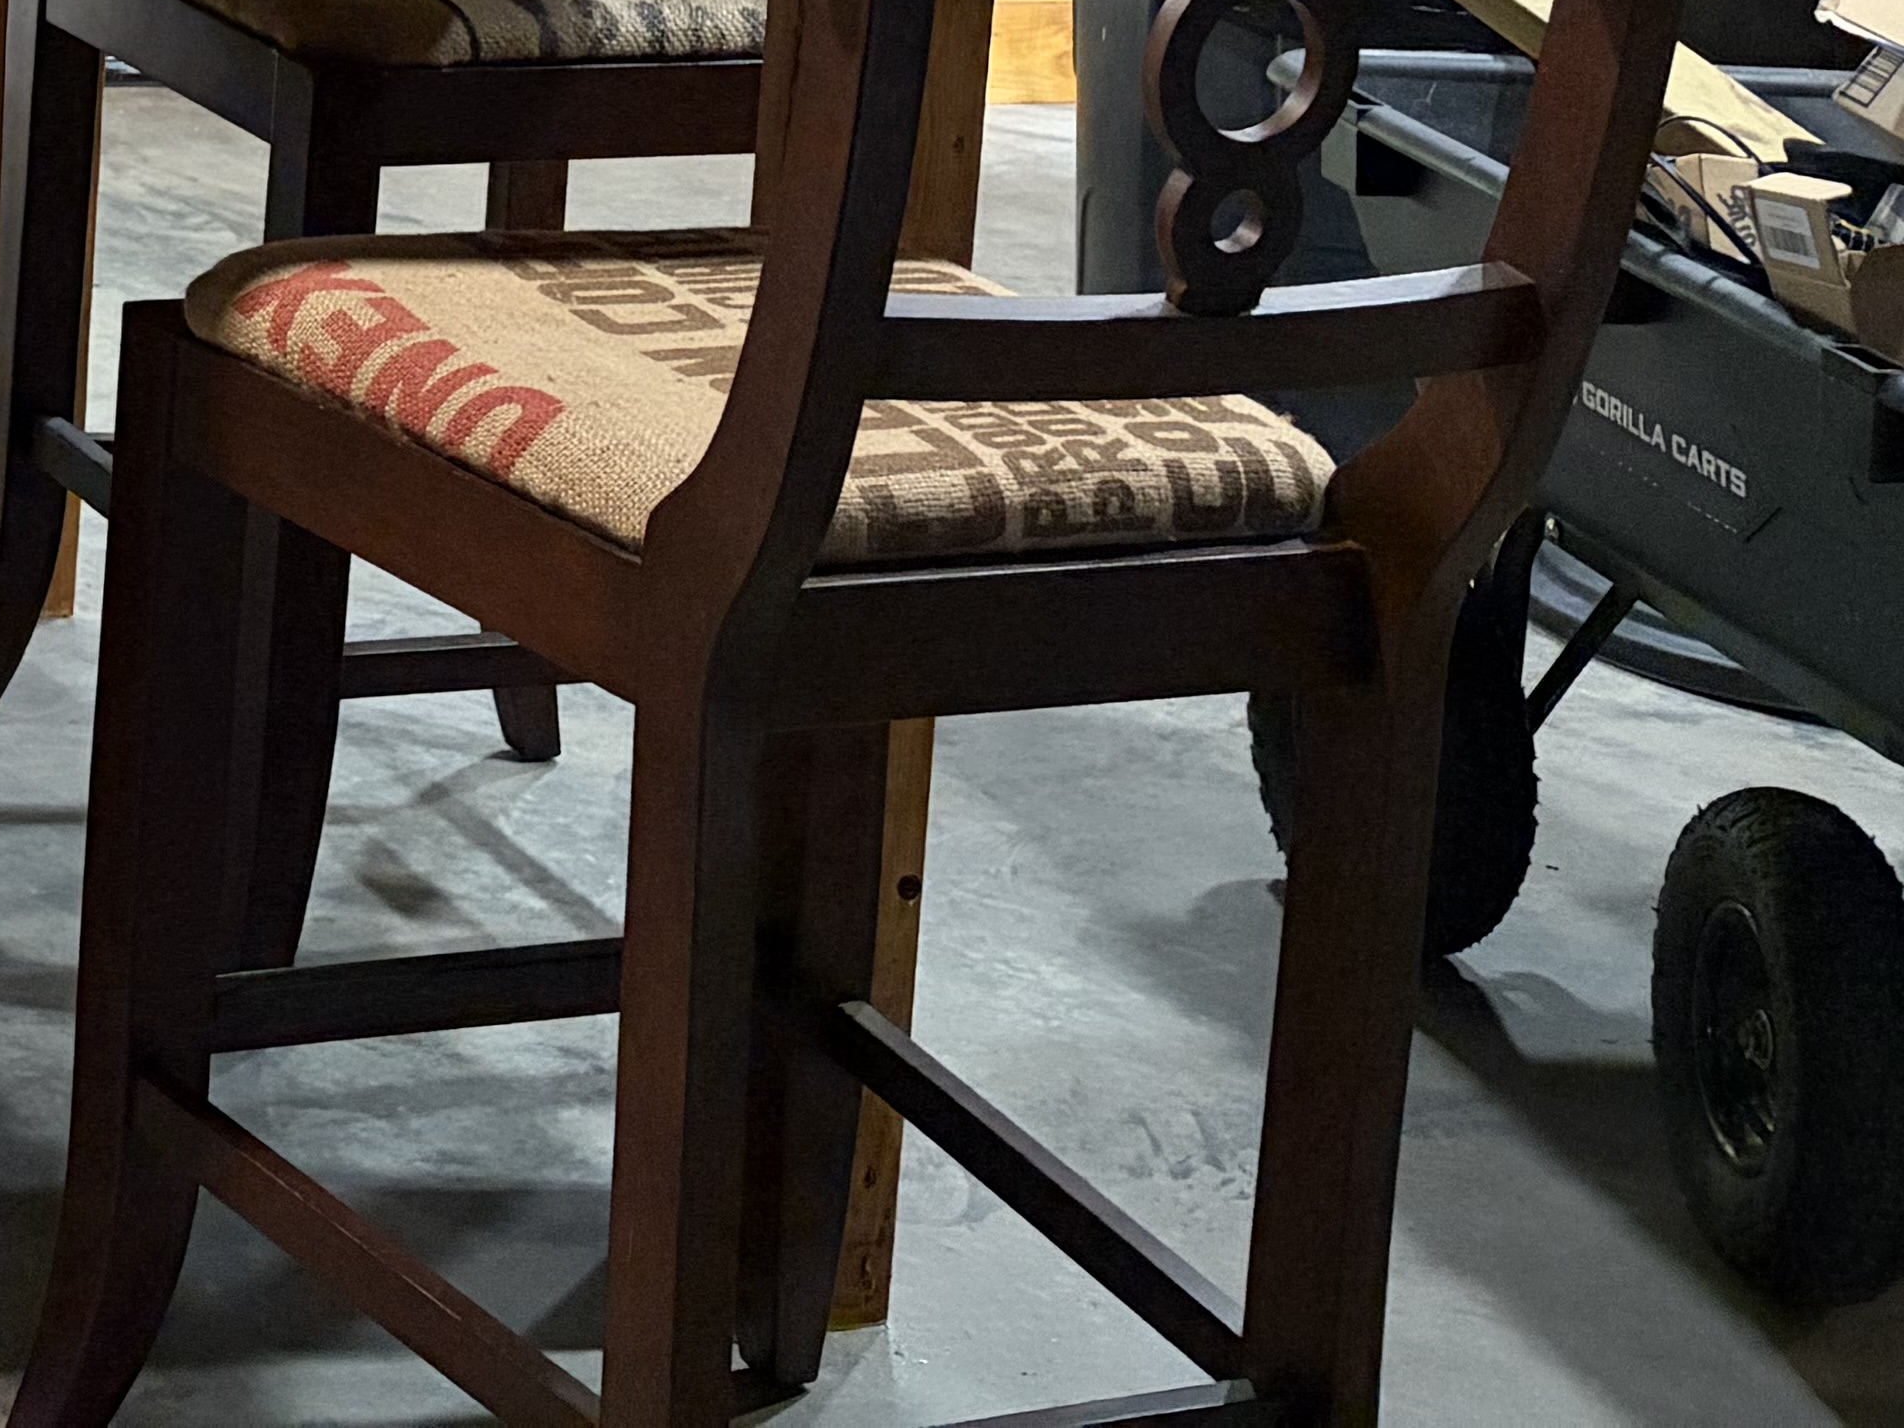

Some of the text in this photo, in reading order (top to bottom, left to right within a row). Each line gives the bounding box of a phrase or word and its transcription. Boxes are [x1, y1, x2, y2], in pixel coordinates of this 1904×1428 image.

[232, 260, 565, 482] UNEX
[1582, 380, 1747, 498] GORILLA CARTS
